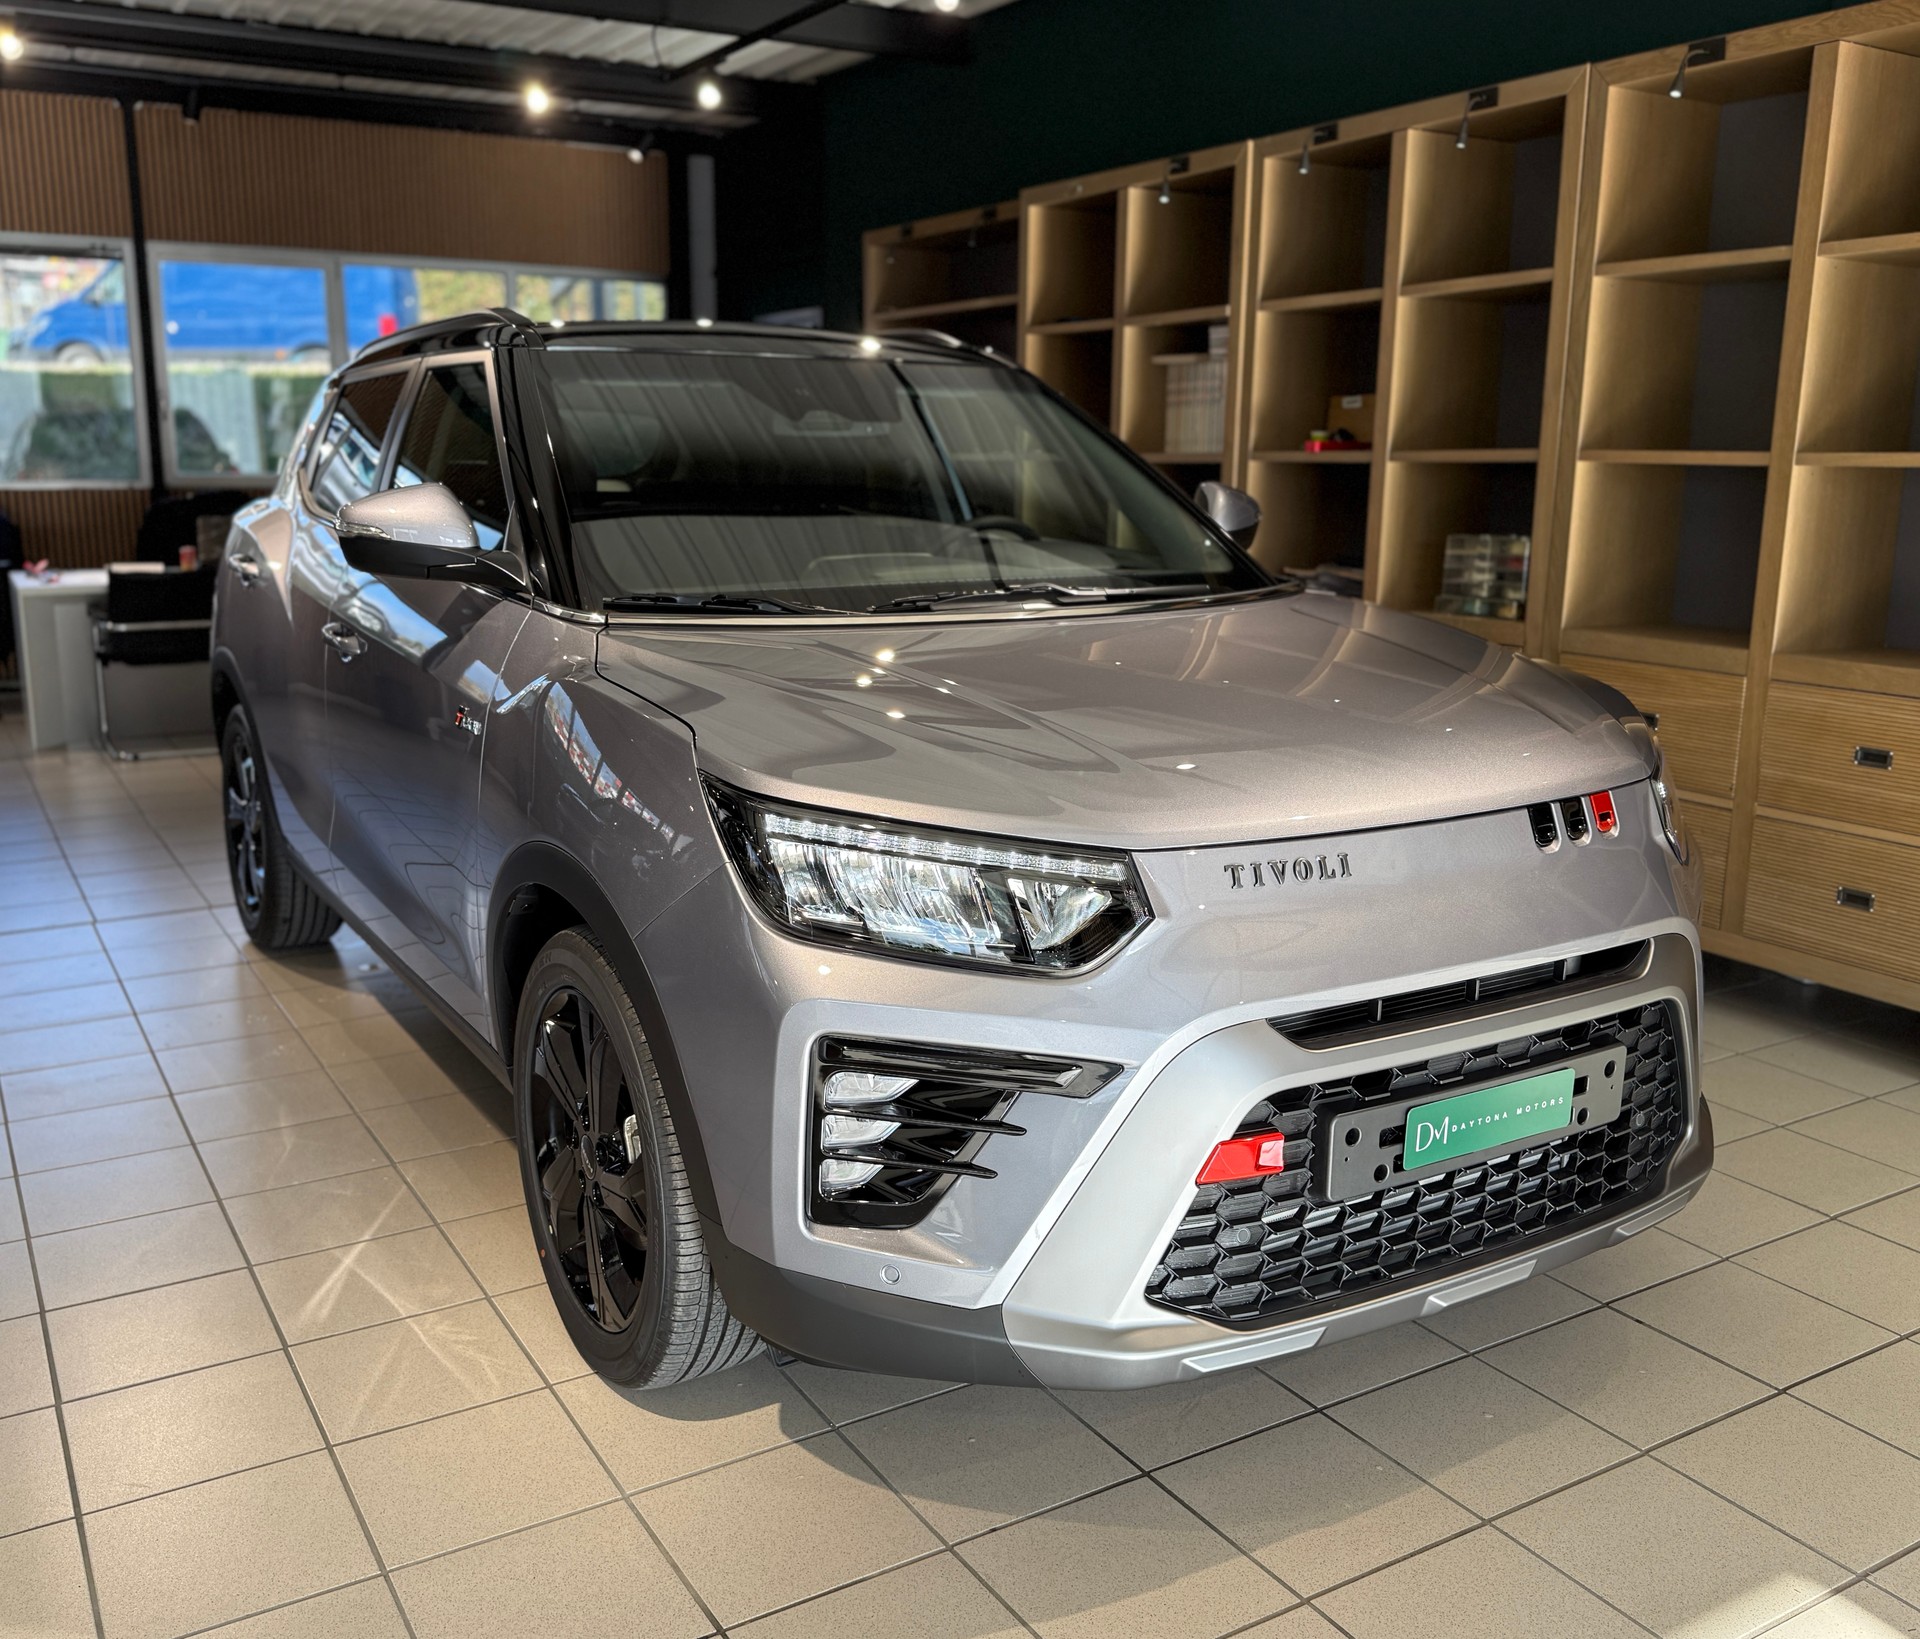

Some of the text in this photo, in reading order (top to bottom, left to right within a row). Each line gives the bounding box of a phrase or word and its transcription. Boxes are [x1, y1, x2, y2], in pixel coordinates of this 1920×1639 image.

[1224, 853, 1352, 889] TIVOLI
[1452, 1111, 1508, 1132] DAYTONA
[1516, 1097, 1564, 1115] MOTORS
